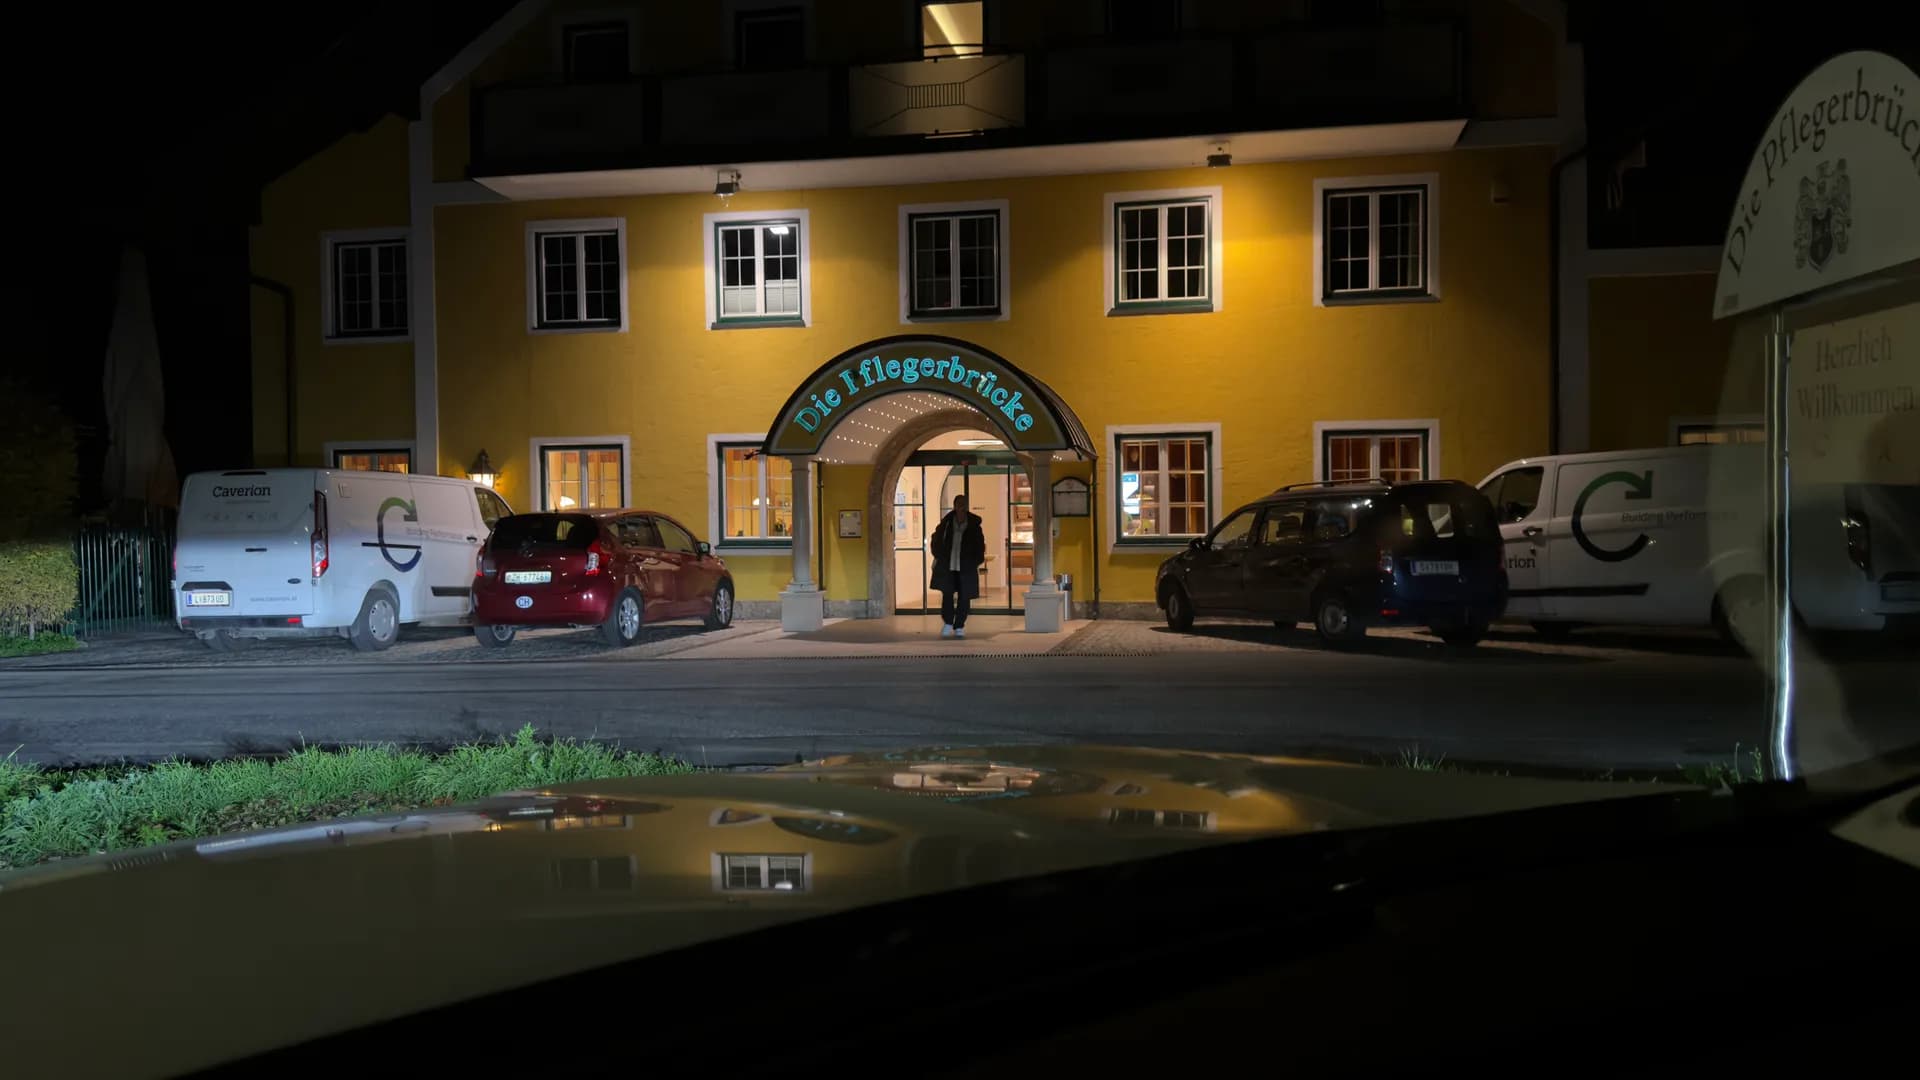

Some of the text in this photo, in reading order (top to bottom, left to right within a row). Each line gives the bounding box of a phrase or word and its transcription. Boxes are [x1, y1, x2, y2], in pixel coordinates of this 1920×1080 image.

[1727, 188, 1763, 279] Die
[1815, 325, 1892, 374] Herzlich
[793, 387, 842, 433] Die
[1797, 383, 1914, 421] Willkommen
[212, 483, 271, 498] Caverion
[518, 597, 530, 607] CH
